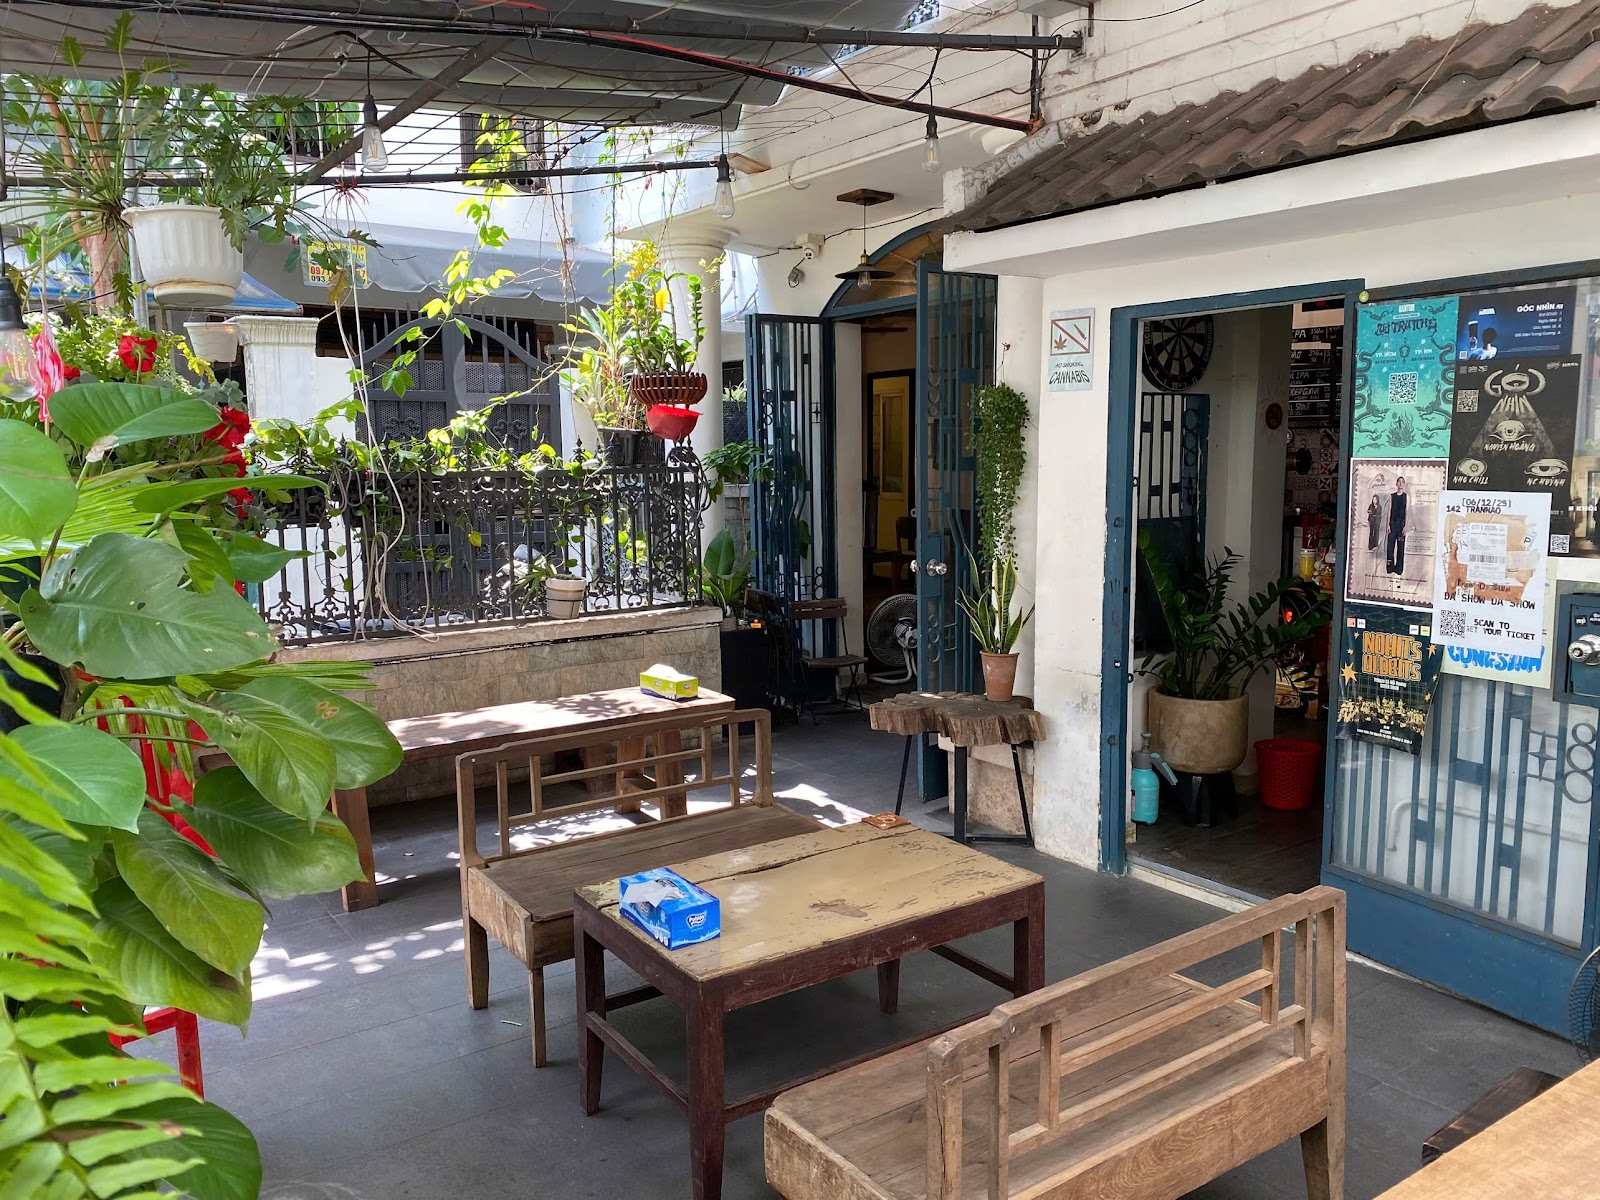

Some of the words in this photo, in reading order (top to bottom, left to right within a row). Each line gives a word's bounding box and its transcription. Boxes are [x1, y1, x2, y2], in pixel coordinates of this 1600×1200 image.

[1516, 304, 1535, 313] GÓC
[1536, 302, 1555, 311] NHÌN
[1049, 369, 1091, 385] CANNABIS
[1446, 505, 1461, 513] 142
[1444, 591, 1456, 601] DA
[1461, 593, 1485, 604] SHOW
[1473, 618, 1495, 628] SCAN
[1499, 621, 1510, 630] TO
[1483, 627, 1502, 637] YOUR
[1507, 631, 1535, 641] TICKET
